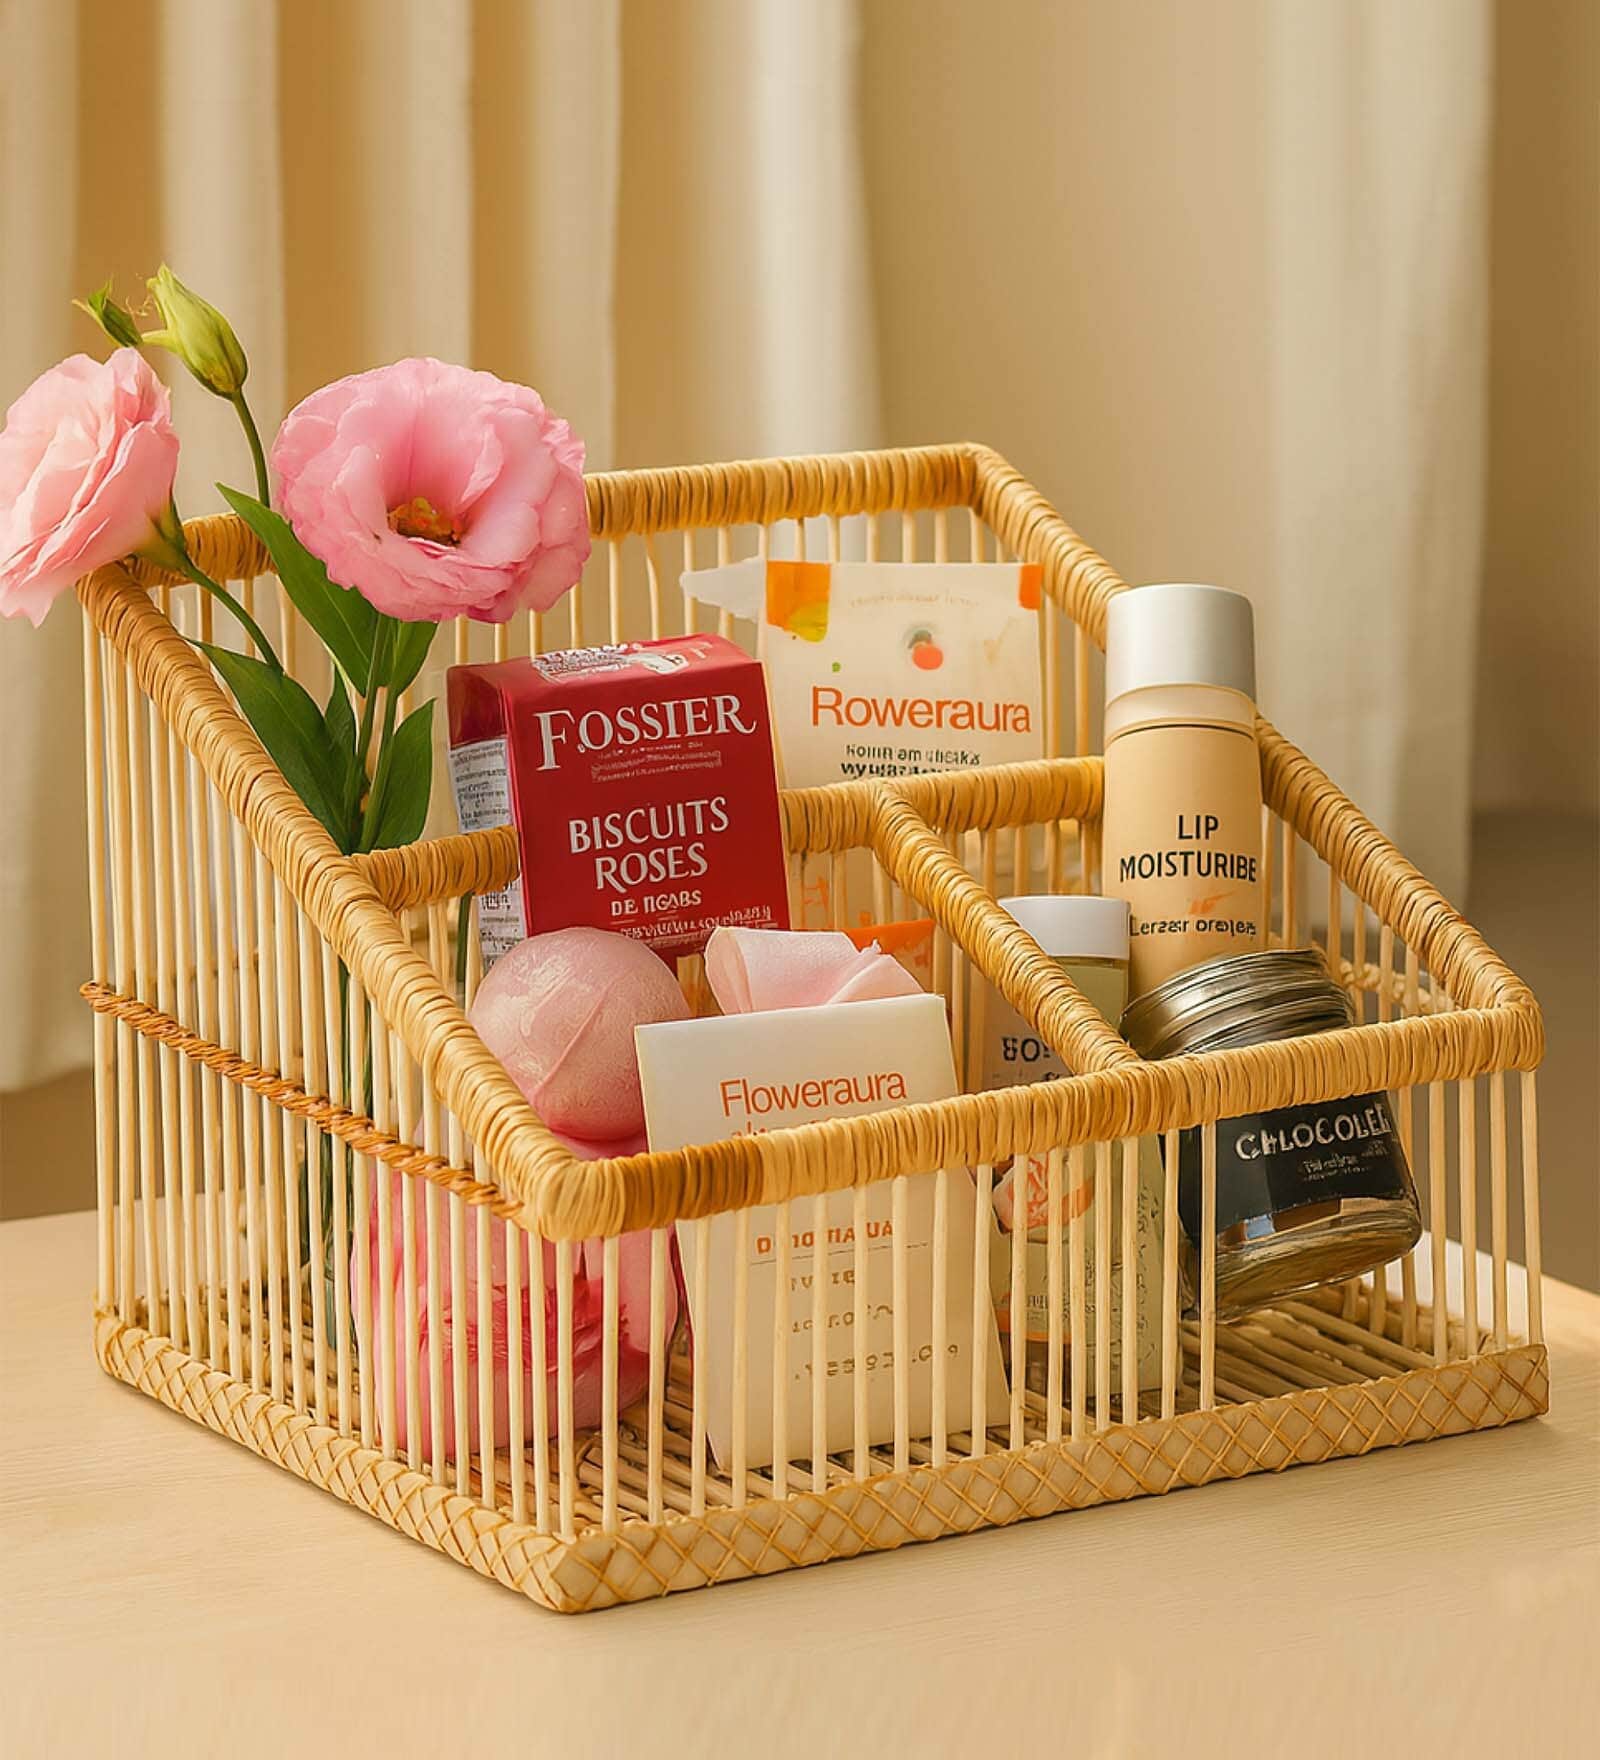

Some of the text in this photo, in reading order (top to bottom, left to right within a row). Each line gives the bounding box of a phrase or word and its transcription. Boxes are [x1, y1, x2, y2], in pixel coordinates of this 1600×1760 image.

[811, 686, 1031, 733] Roweraura
[534, 695, 757, 771] FOSSIER
[568, 797, 730, 854] BISCUITS
[1178, 815, 1219, 840] LIP
[595, 842, 708, 893] ROSES
[1119, 851, 1257, 883] MOISTURIBE
[611, 900, 638, 916] DE
[719, 1071, 907, 1117] Floweraura
